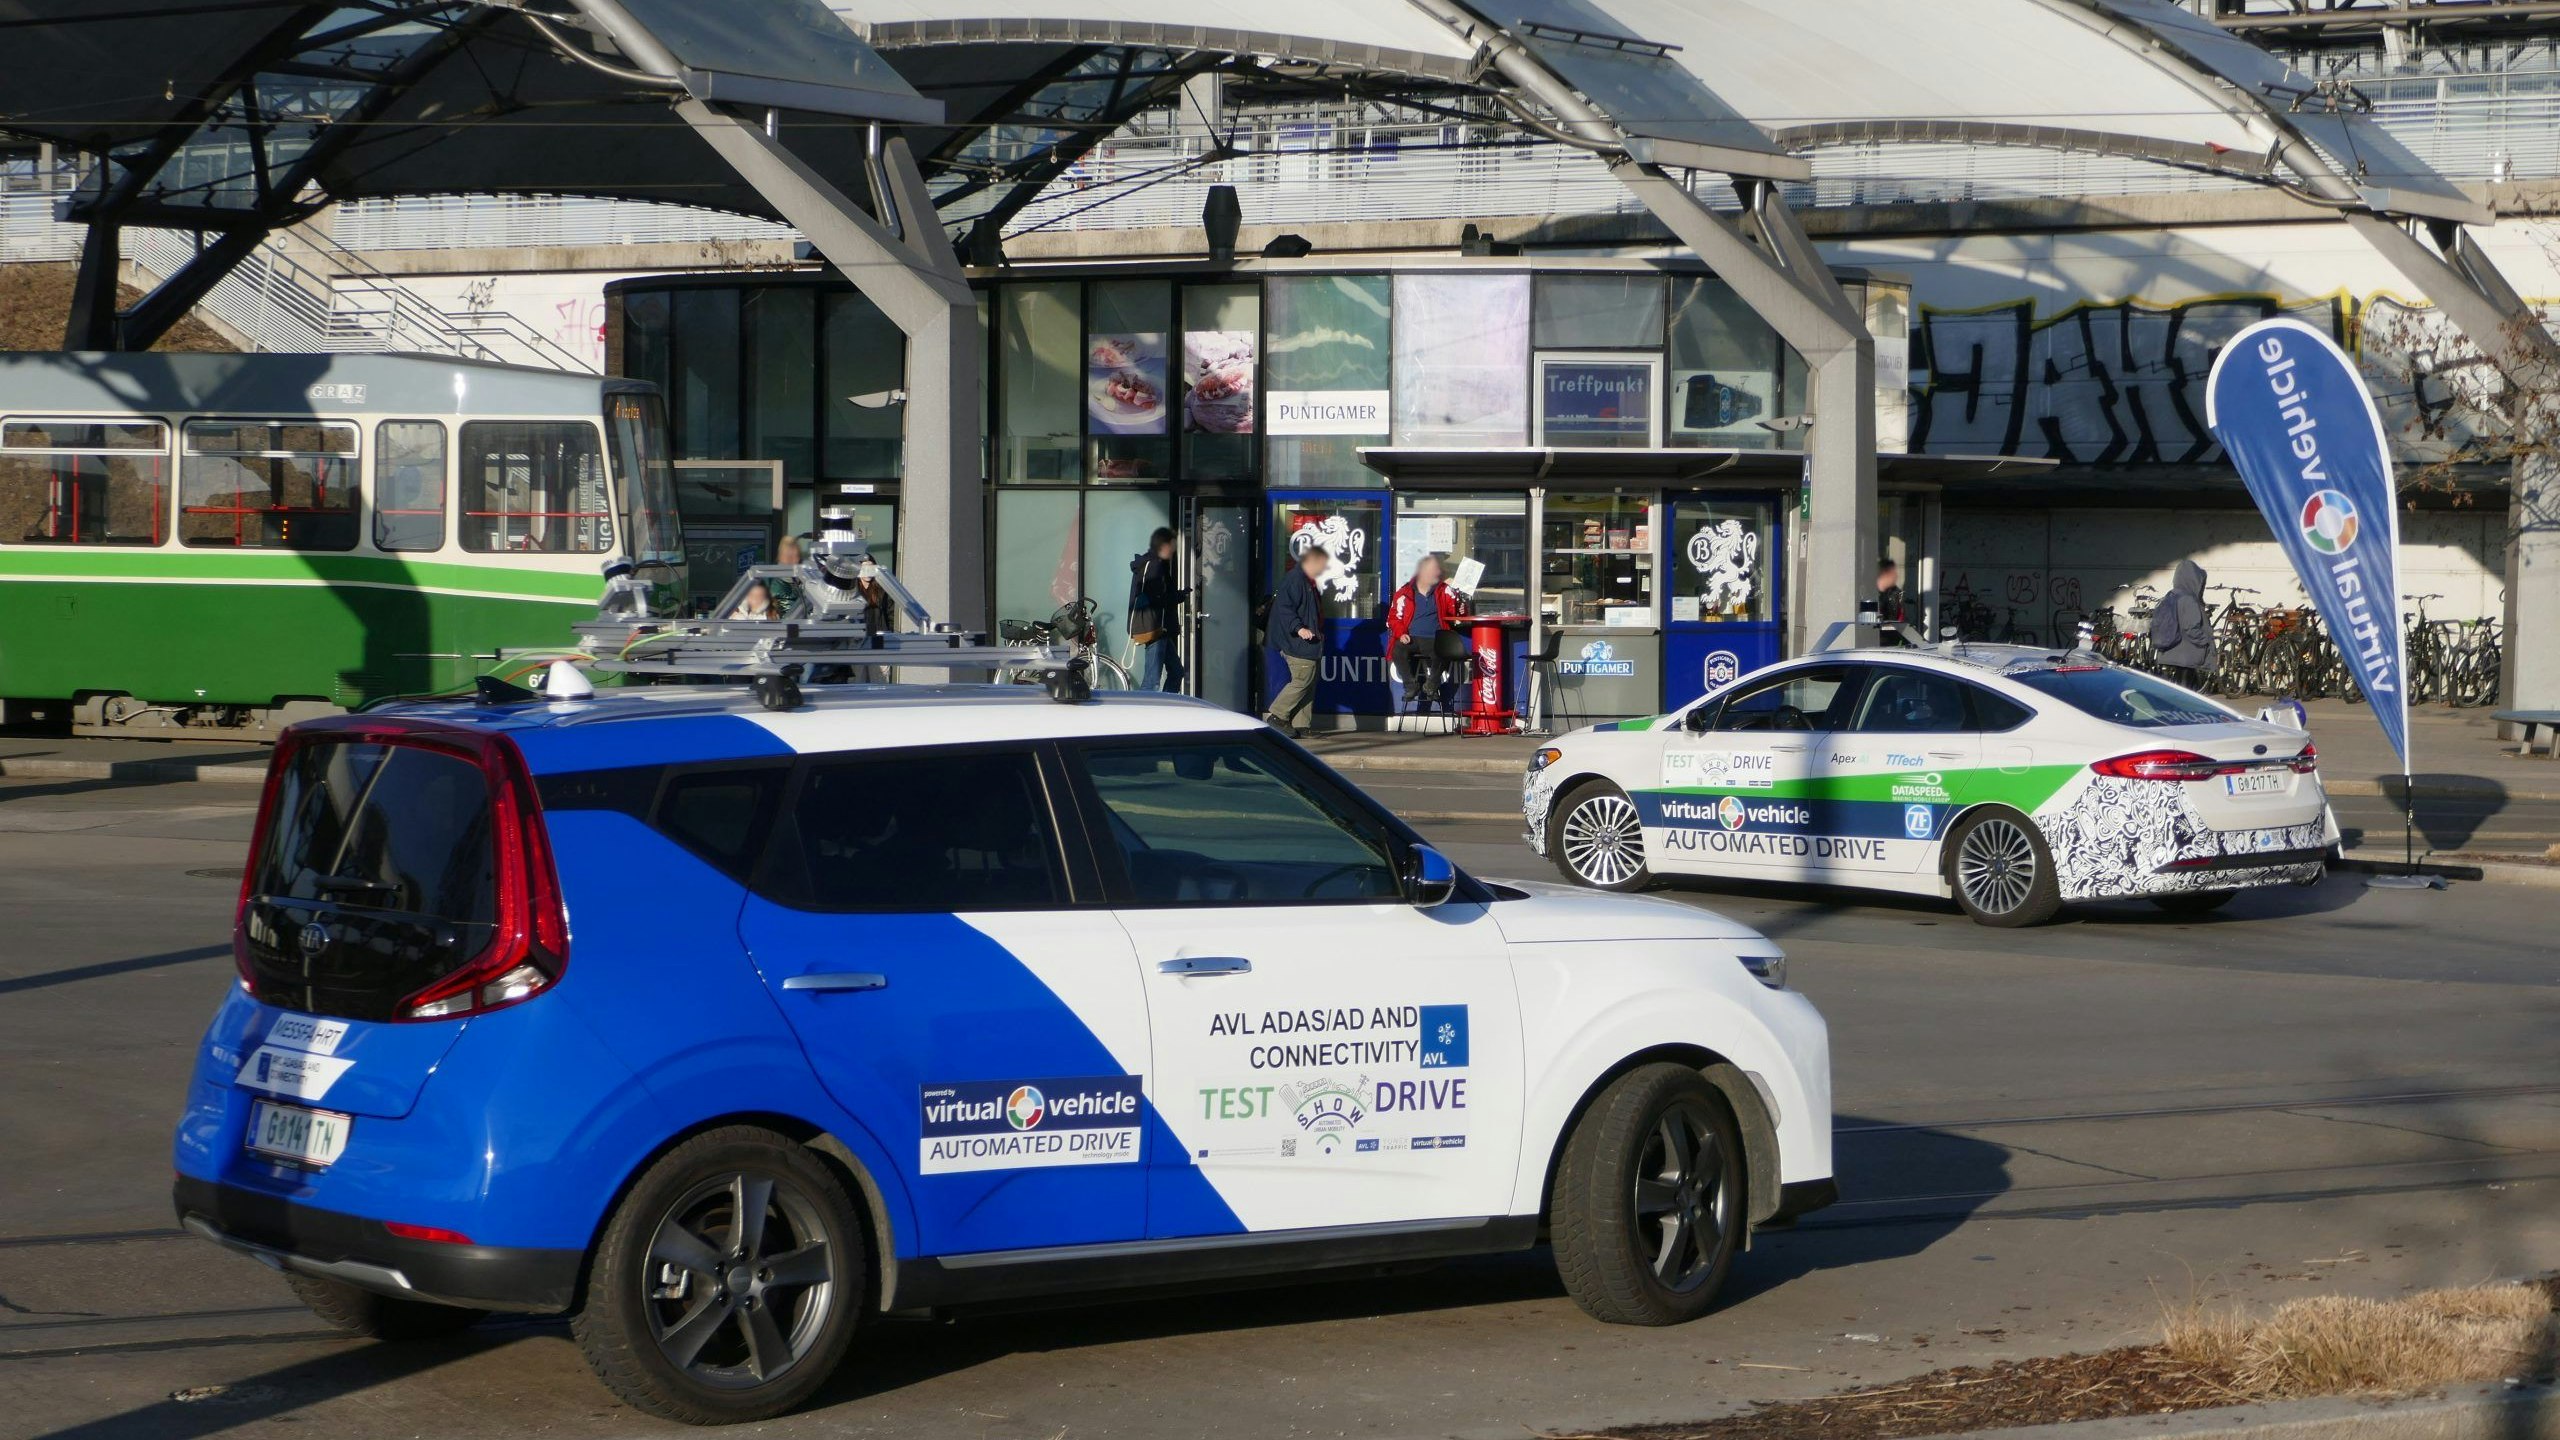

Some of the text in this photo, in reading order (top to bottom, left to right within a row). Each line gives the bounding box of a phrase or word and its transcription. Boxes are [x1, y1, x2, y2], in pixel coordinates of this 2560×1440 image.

[312, 385, 364, 398] GRAZ
[1546, 374, 1644, 397] Treffpunkt
[1279, 404, 1376, 420] PUNTIGAMER
[1803, 459, 1811, 482] A
[1802, 494, 1808, 513] 5
[1563, 662, 1630, 674] PUNTIGAMER
[1666, 755, 1772, 769] TEST DRIVE
[1892, 785, 1942, 797] DATASPEED
[2238, 775, 2279, 791] G 217 TH
[1662, 801, 1809, 824] virtual vehicle
[1665, 830, 1886, 860] AUTOMATED DRIVE
[1210, 1006, 1418, 1036] AVL ADAS/AD AND
[274, 1020, 342, 1047] MESSFAHRT
[1250, 1040, 1419, 1069] CONNECTIVITY
[1423, 1051, 1447, 1065] AVL
[926, 1091, 1136, 1123] virtual vehicle
[1200, 1079, 1467, 1120] TEST DRIVE
[1297, 1097, 1364, 1127] SHOW
[267, 1111, 335, 1156] G 141 TN
[930, 1132, 1132, 1160] AUTOMATED DRIVE
